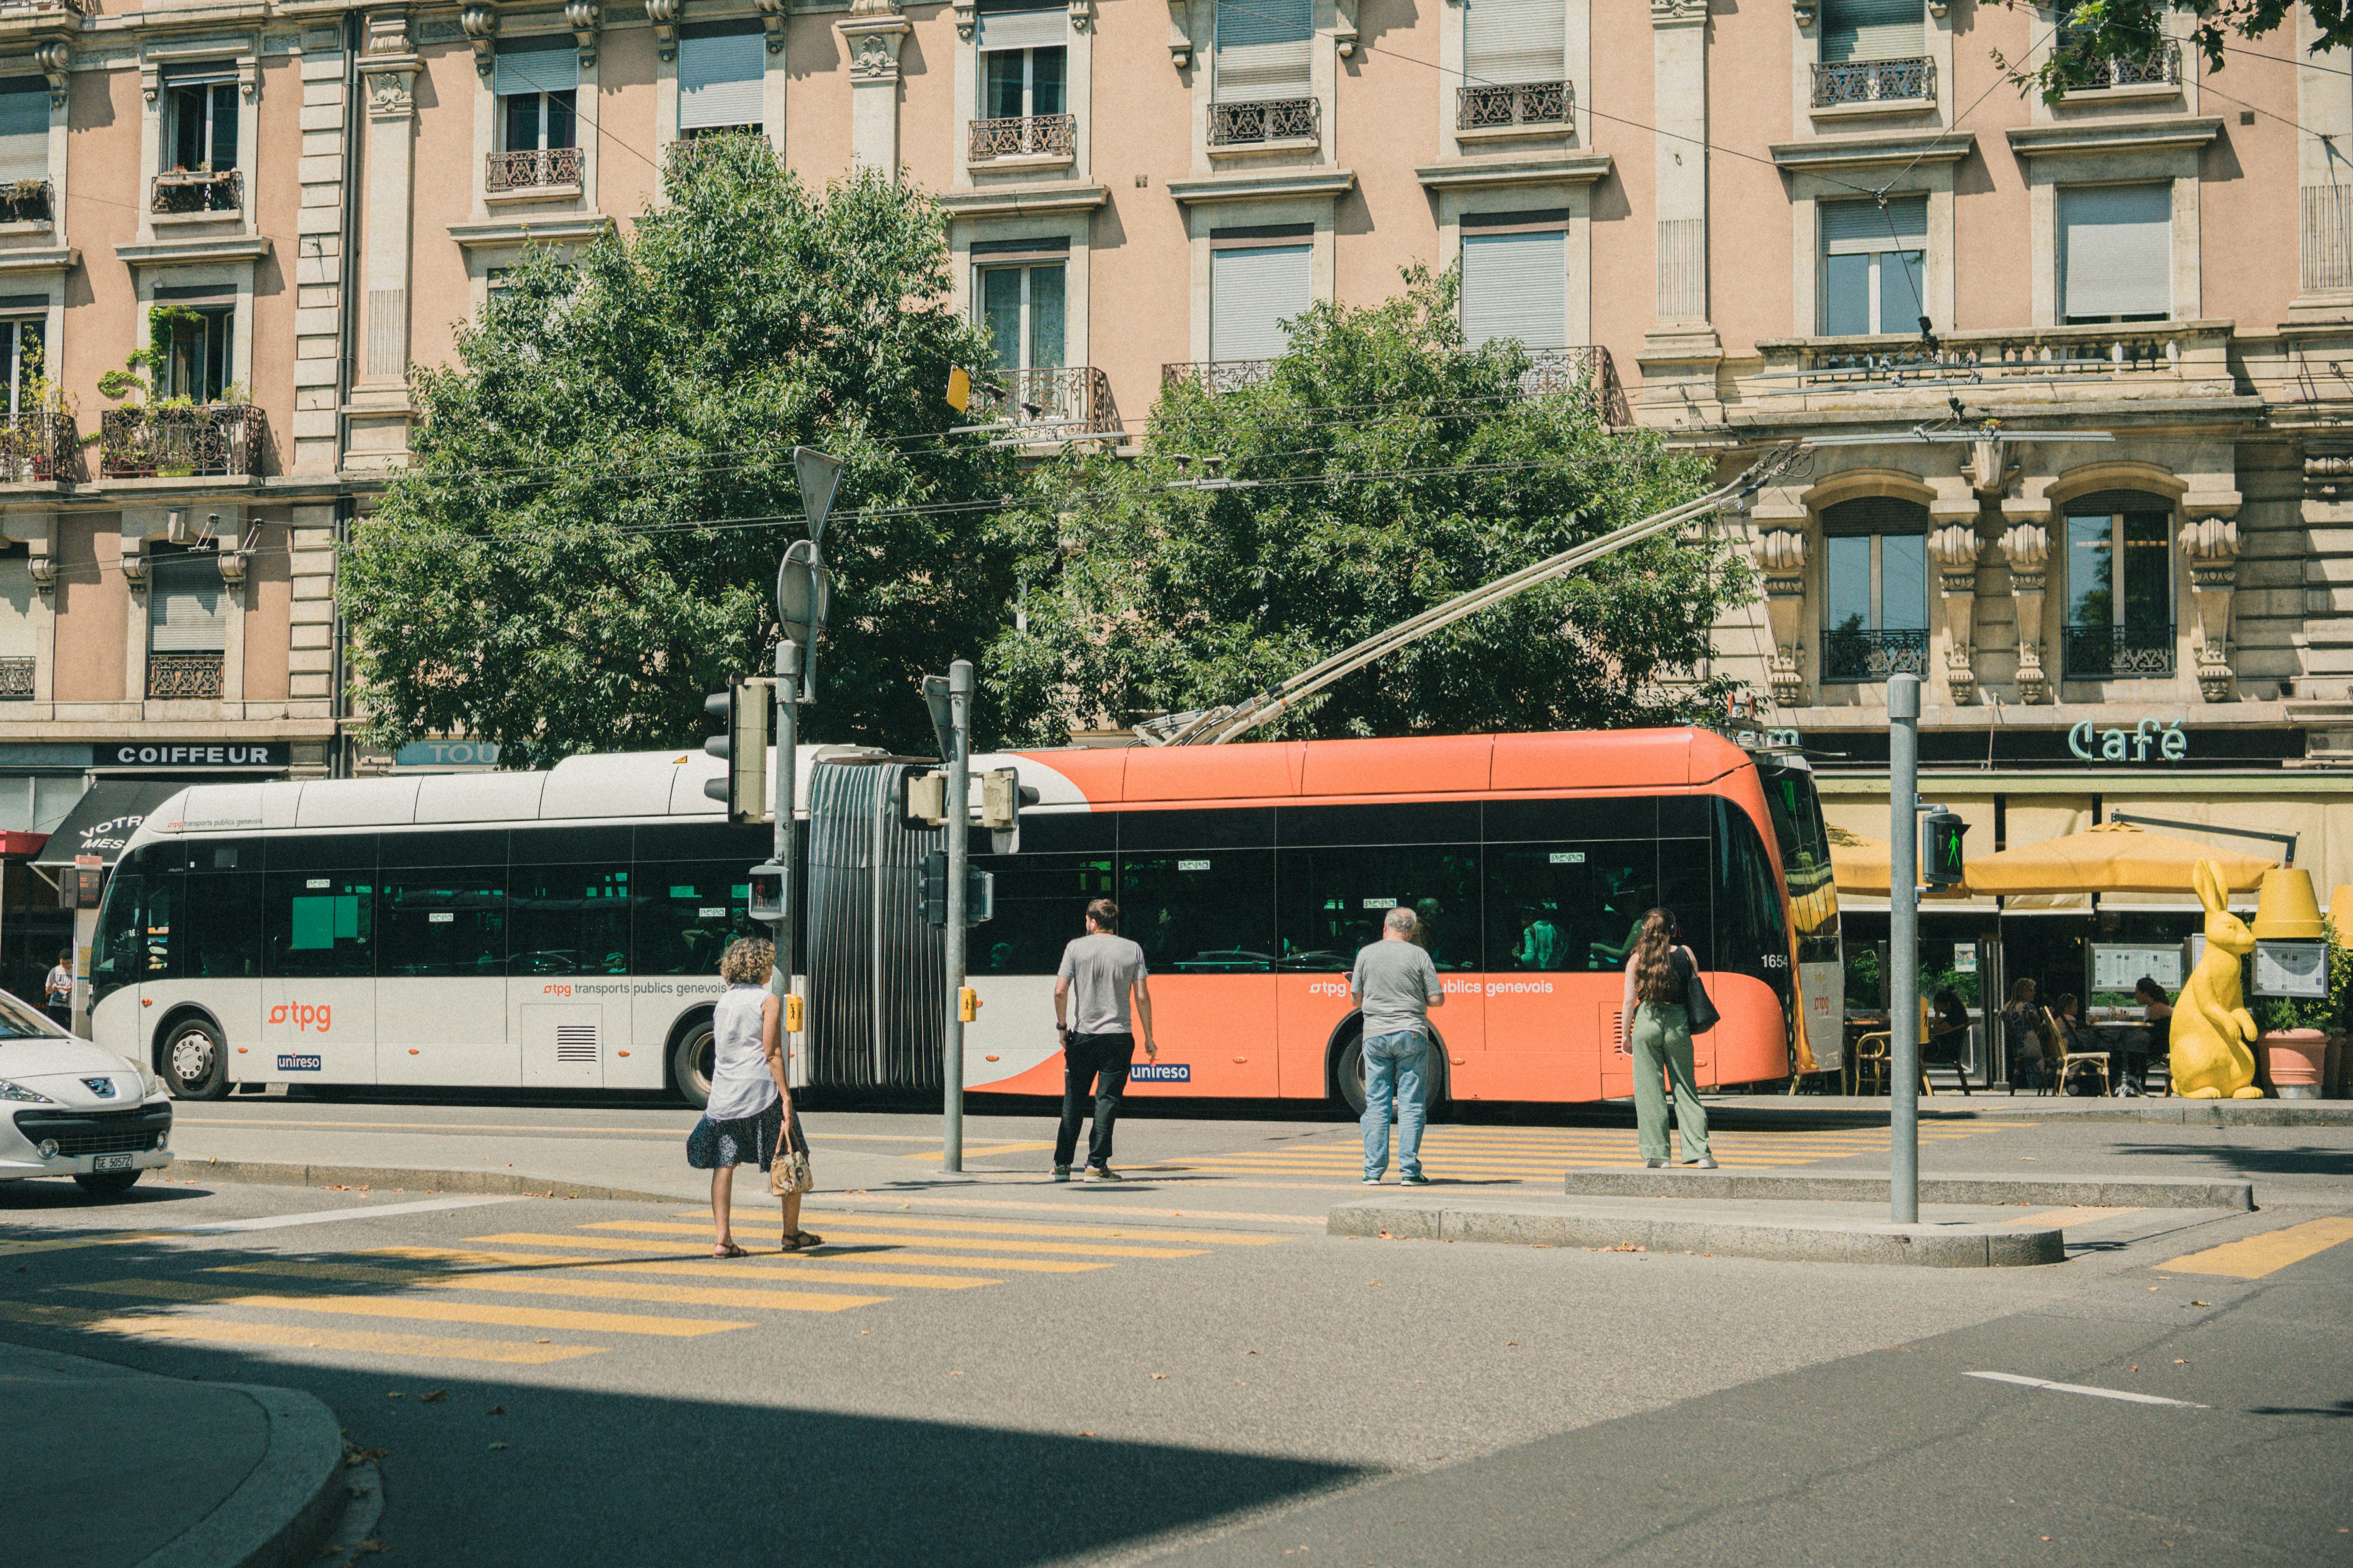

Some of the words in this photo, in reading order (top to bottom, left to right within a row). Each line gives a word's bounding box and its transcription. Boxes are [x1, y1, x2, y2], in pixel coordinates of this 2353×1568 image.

[2068, 717, 2186, 761] Café
[118, 747, 268, 763] COIFFEUR
[428, 744, 499, 763] TOU
[79, 815, 143, 838] VOTR
[81, 838, 125, 849] MES
[1761, 954, 1788, 968] 1654
[575, 983, 629, 996] transports
[634, 982, 673, 996] publics
[677, 982, 727, 996] genevois
[1442, 979, 1481, 993] blics
[1486, 980, 1553, 997] genevois
[278, 1053, 319, 1068] unireso
[1131, 1062, 1188, 1078] unireso
